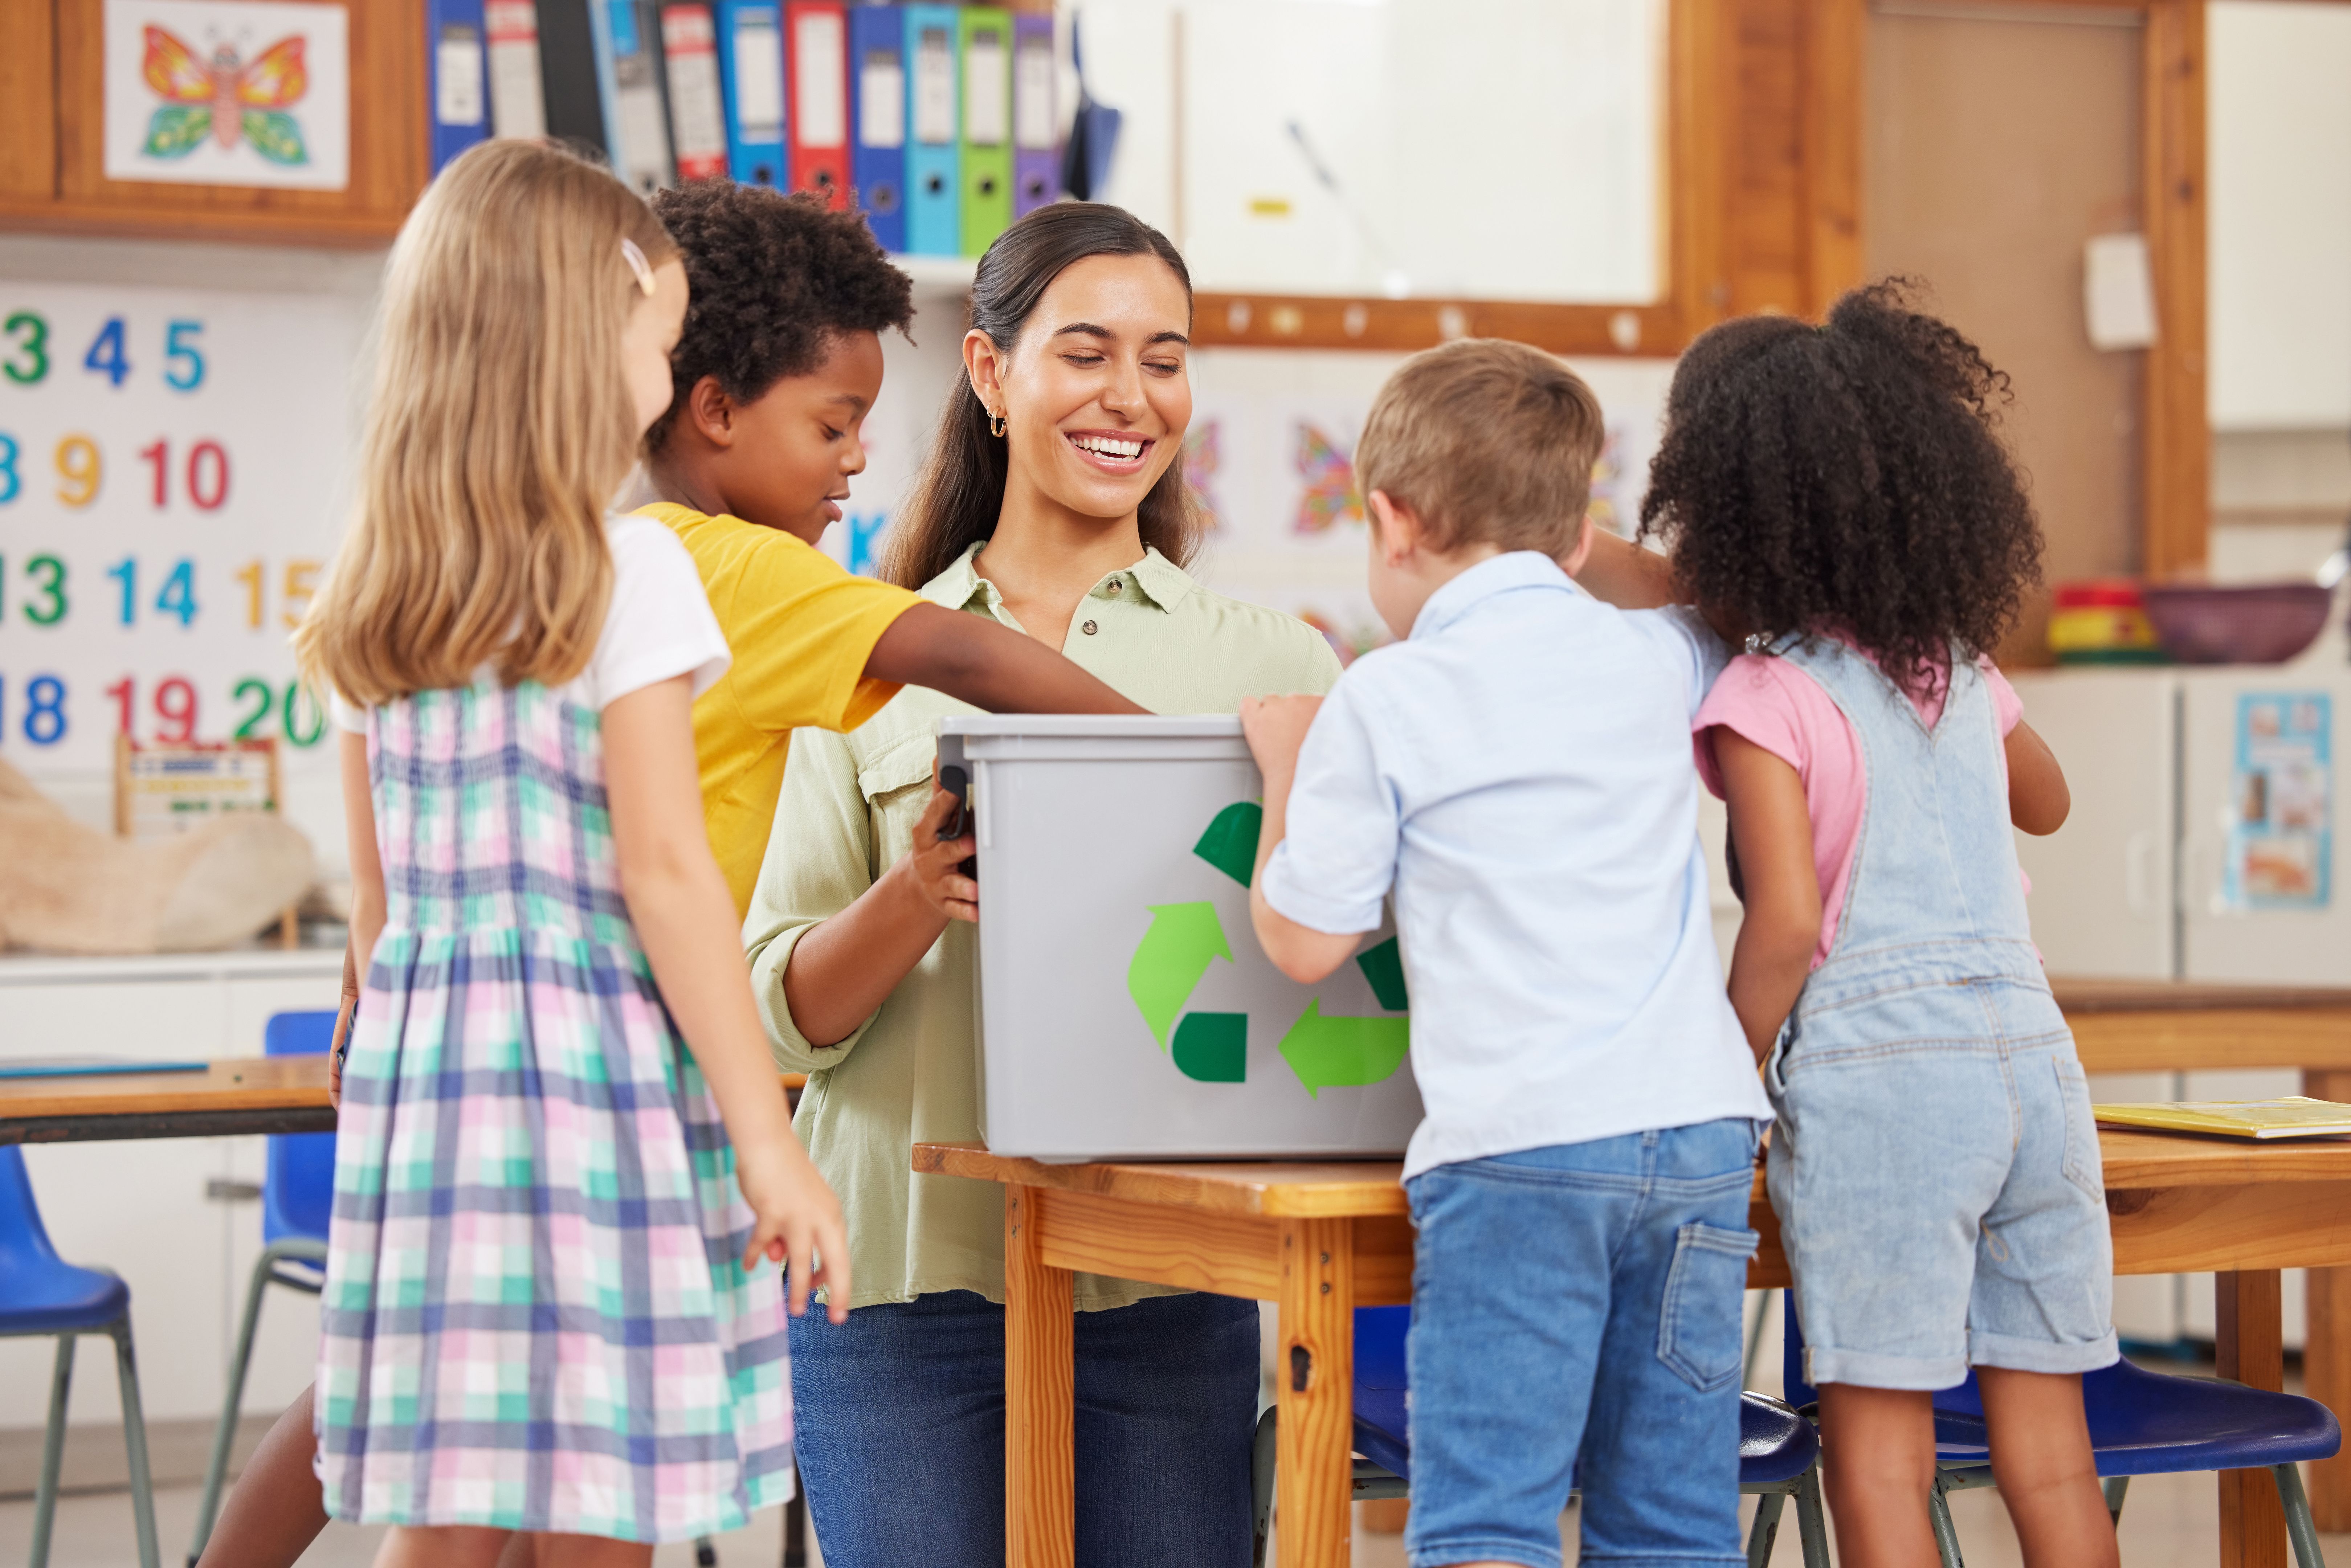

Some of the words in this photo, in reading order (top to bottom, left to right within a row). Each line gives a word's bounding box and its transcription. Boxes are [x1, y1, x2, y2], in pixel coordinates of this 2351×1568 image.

[1, 312, 49, 384] 3
[84, 317, 130, 387] 4
[165, 321, 205, 392] 5
[53, 434, 101, 508] 9
[140, 439, 230, 511] 10
[0, 554, 68, 626] 3
[107, 557, 199, 628] 14
[0, 674, 68, 746] 8
[106, 676, 197, 747] 19
[232, 678, 324, 747] 20
